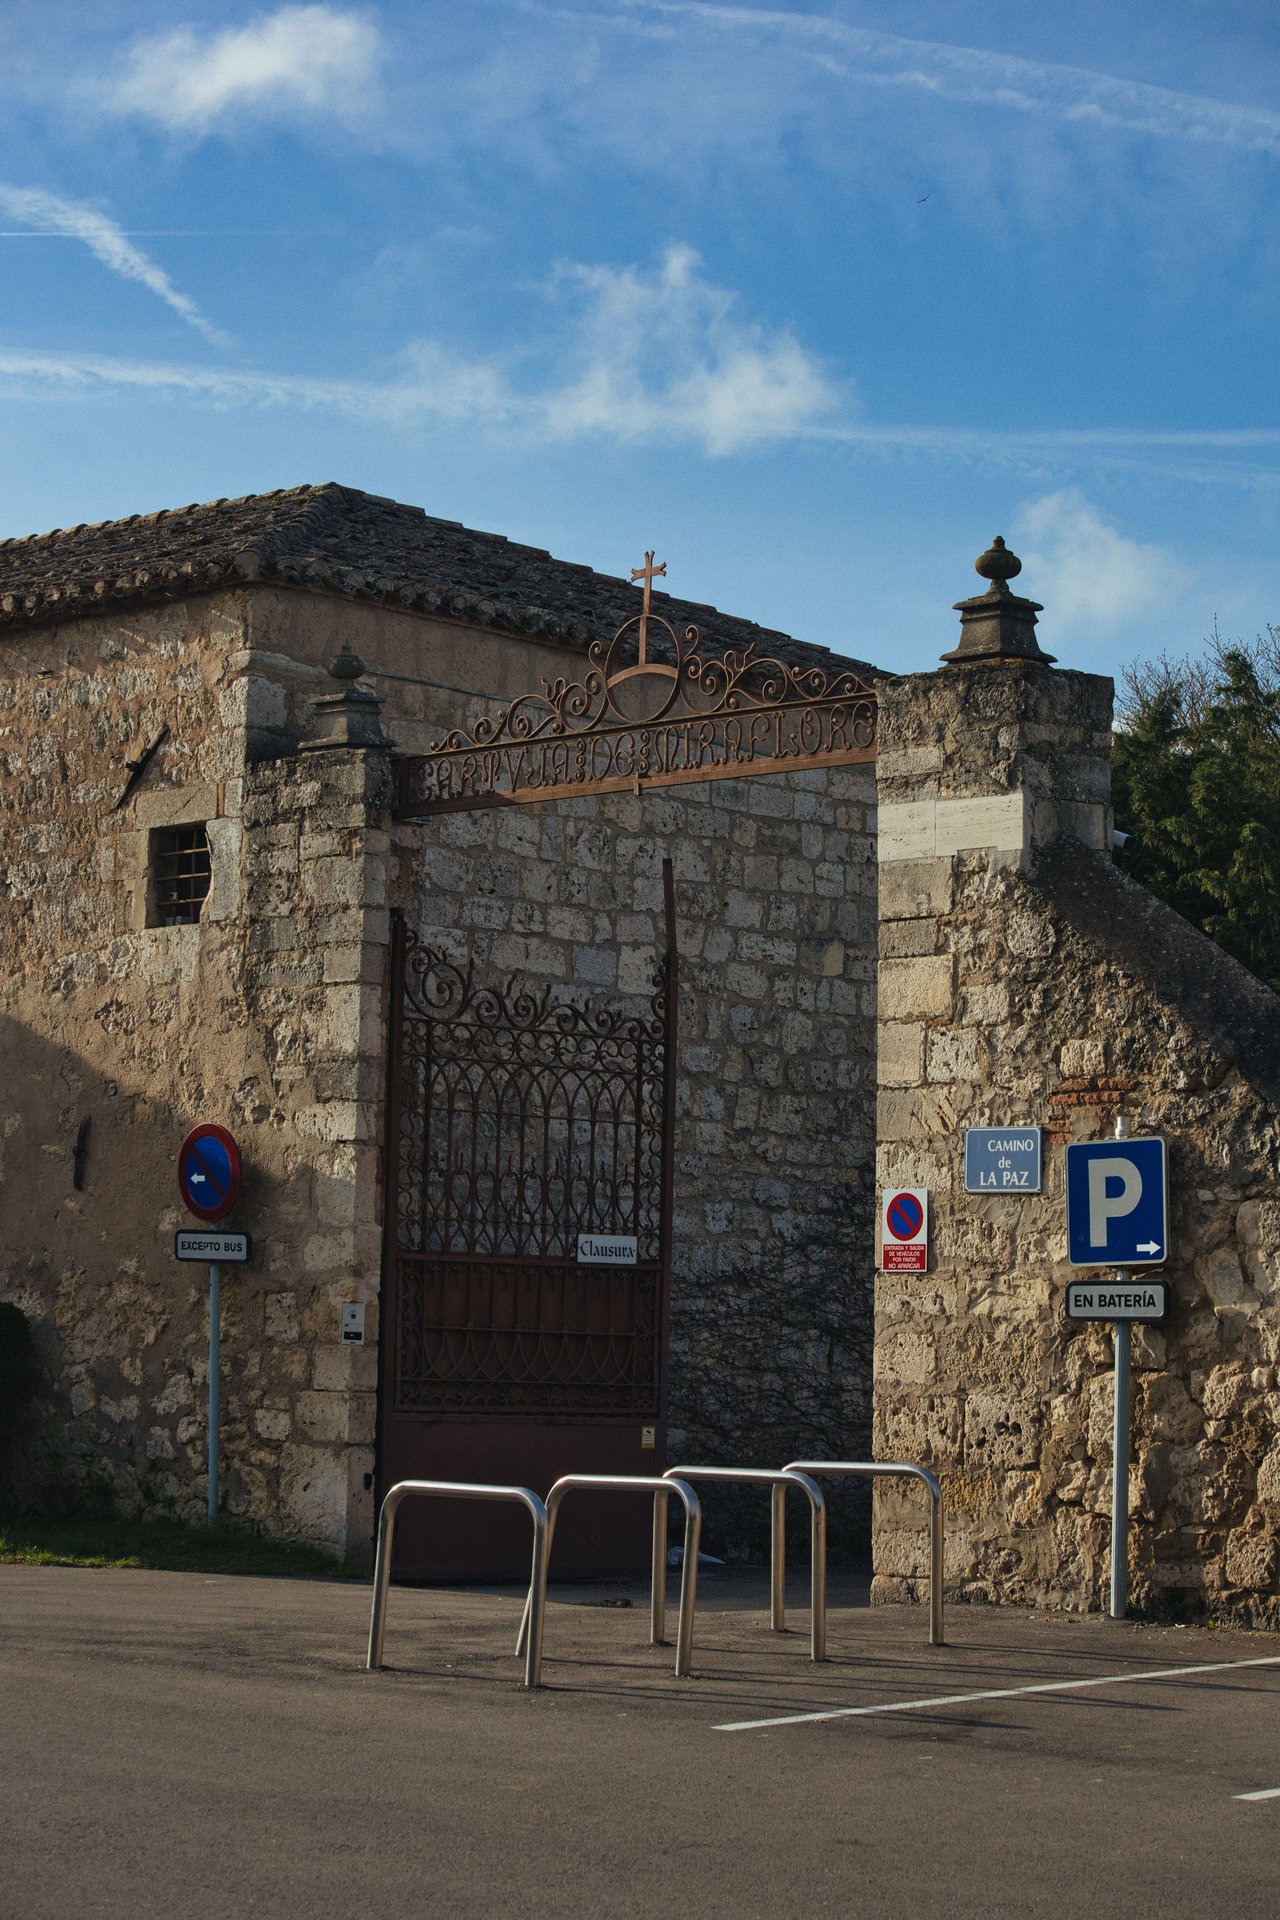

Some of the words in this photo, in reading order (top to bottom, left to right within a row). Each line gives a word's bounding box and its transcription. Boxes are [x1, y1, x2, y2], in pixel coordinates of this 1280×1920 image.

[987, 1139, 1034, 1152] CAMINO
[998, 1156, 1012, 1169] de
[980, 1171, 997, 1186] LA
[1002, 1171, 1029, 1186] PAZ
[1088, 1157, 1143, 1248] P
[181, 1241, 221, 1252] EXCEPTO
[223, 1242, 243, 1253] BUS
[1074, 1294, 1094, 1308] EN
[1098, 1290, 1157, 1308] BATERÍA
